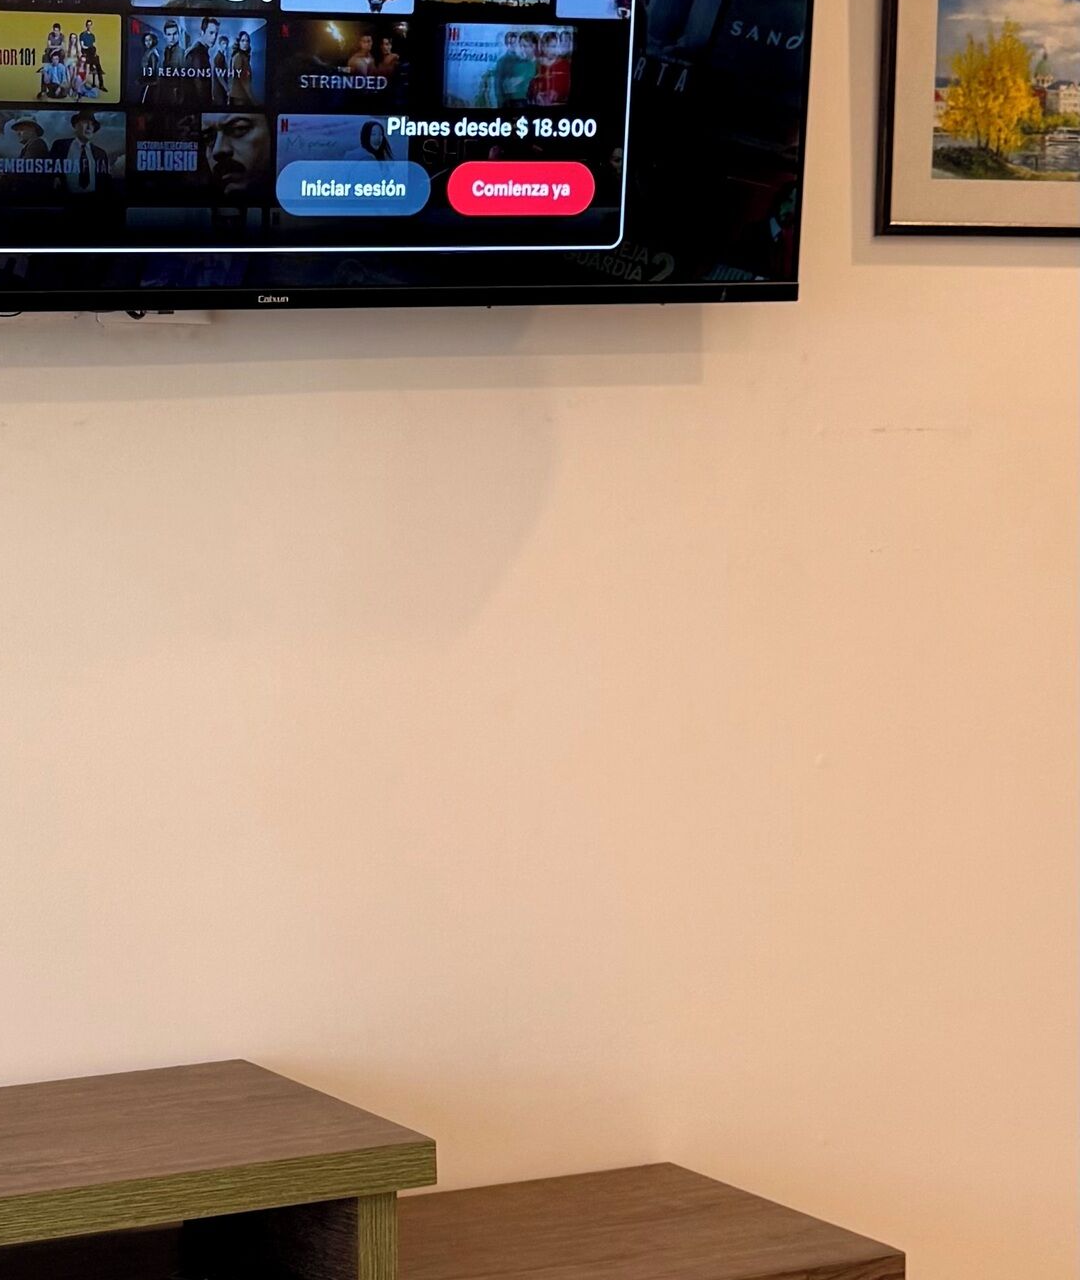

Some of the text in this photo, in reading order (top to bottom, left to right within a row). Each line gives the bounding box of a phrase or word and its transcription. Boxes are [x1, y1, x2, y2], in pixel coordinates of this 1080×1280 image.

[19, 49, 36, 67] 101
[142, 67, 243, 79] 13 REASONS WHY
[299, 74, 388, 91] STRANDED
[386, 116, 597, 139] Planes desde $ 18.900
[136, 151, 198, 171] COLOSIO
[301, 180, 406, 197] Iniciar sesión
[471, 179, 571, 201] Comienza ya
